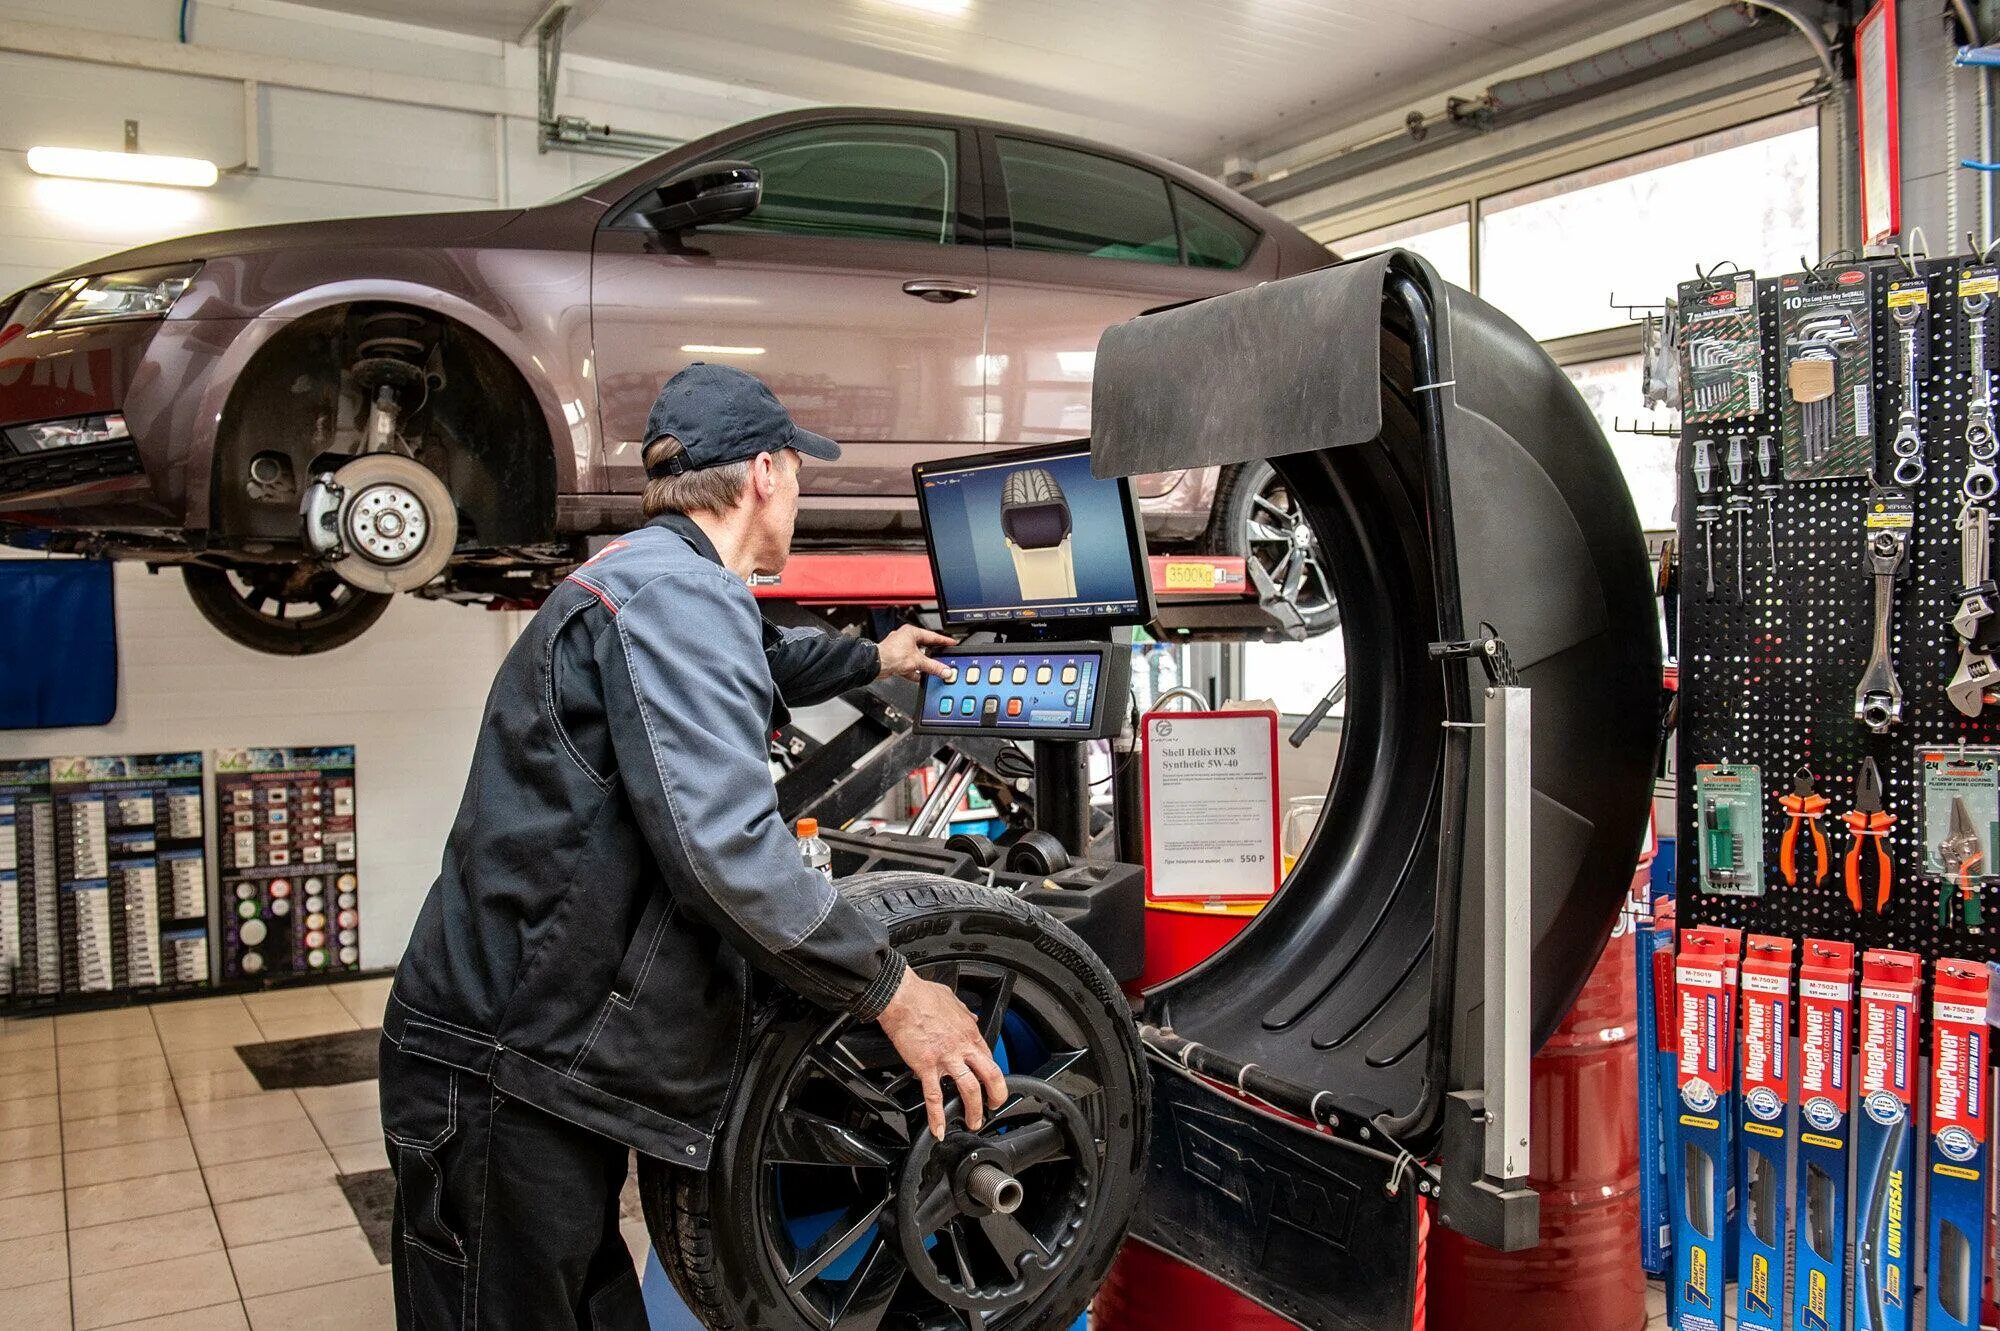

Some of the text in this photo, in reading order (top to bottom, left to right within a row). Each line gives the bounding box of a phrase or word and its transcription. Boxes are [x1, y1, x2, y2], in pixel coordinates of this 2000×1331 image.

[1686, 312, 1694, 322] 7
[1782, 296, 1802, 310] 10
[1162, 747, 1236, 757] Shell Helix HX8
[1162, 759, 1238, 772] Synthetic 5W-40
[1685, 970, 1712, 978] M-75019
[1751, 976, 1779, 984] M-75020
[1809, 982, 1838, 990] M-75021
[1680, 992, 1702, 1075] MegaPower
[1746, 998, 1766, 1082] MegaPower
[1774, 1022, 1782, 1044] WIPER
[1864, 1002, 1888, 1091] MegaPower
[1895, 1008, 1906, 1088] FRAMELESS WIPER BLADE
[1774, 1044, 1782, 1078] FRAMELESS
[1803, 1006, 1825, 1091] MegaPower
[1833, 1010, 1842, 1087] FRAMELESS WIPER BLADE
[1935, 1029, 1962, 1120] MegaPower
[1968, 1034, 1979, 1115] FRAMELESS WIPER BLADE
[1887, 1169, 1904, 1259] UNIVERSAL
[1685, 1280, 1712, 1310] 7
[1745, 1288, 1773, 1319] 7
[1882, 1289, 1904, 1311] 7
[1802, 1306, 1830, 1331] 7
